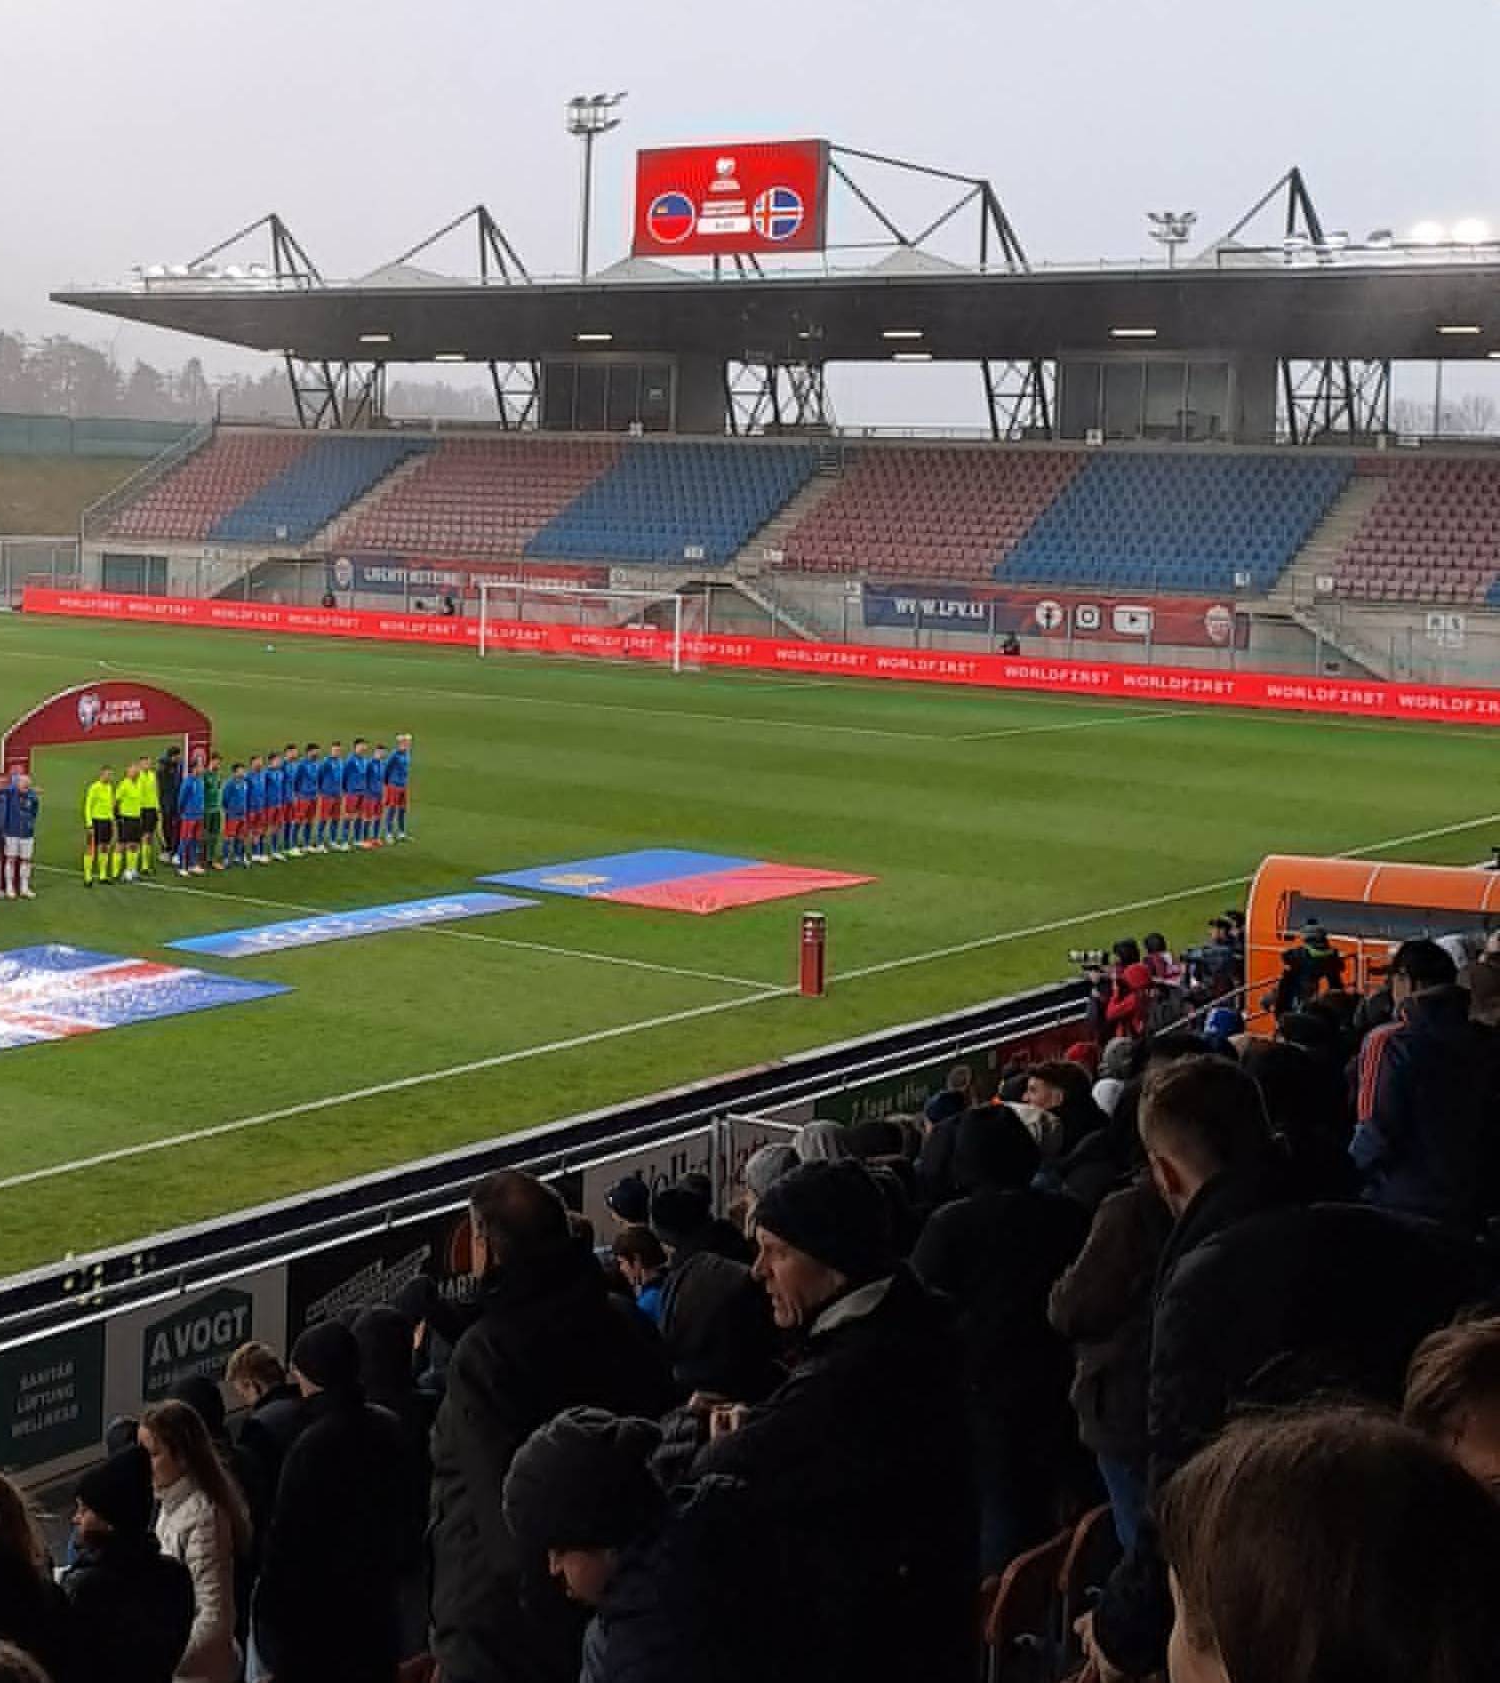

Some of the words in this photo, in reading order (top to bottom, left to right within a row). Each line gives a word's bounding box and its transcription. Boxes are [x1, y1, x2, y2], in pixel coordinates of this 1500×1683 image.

[1004, 666, 1111, 685] WORLDFIRST
[1123, 674, 1235, 694] WORLDFIRST
[1267, 684, 1386, 706] WORLDFIRST
[172, 1304, 248, 1359] VOGT
